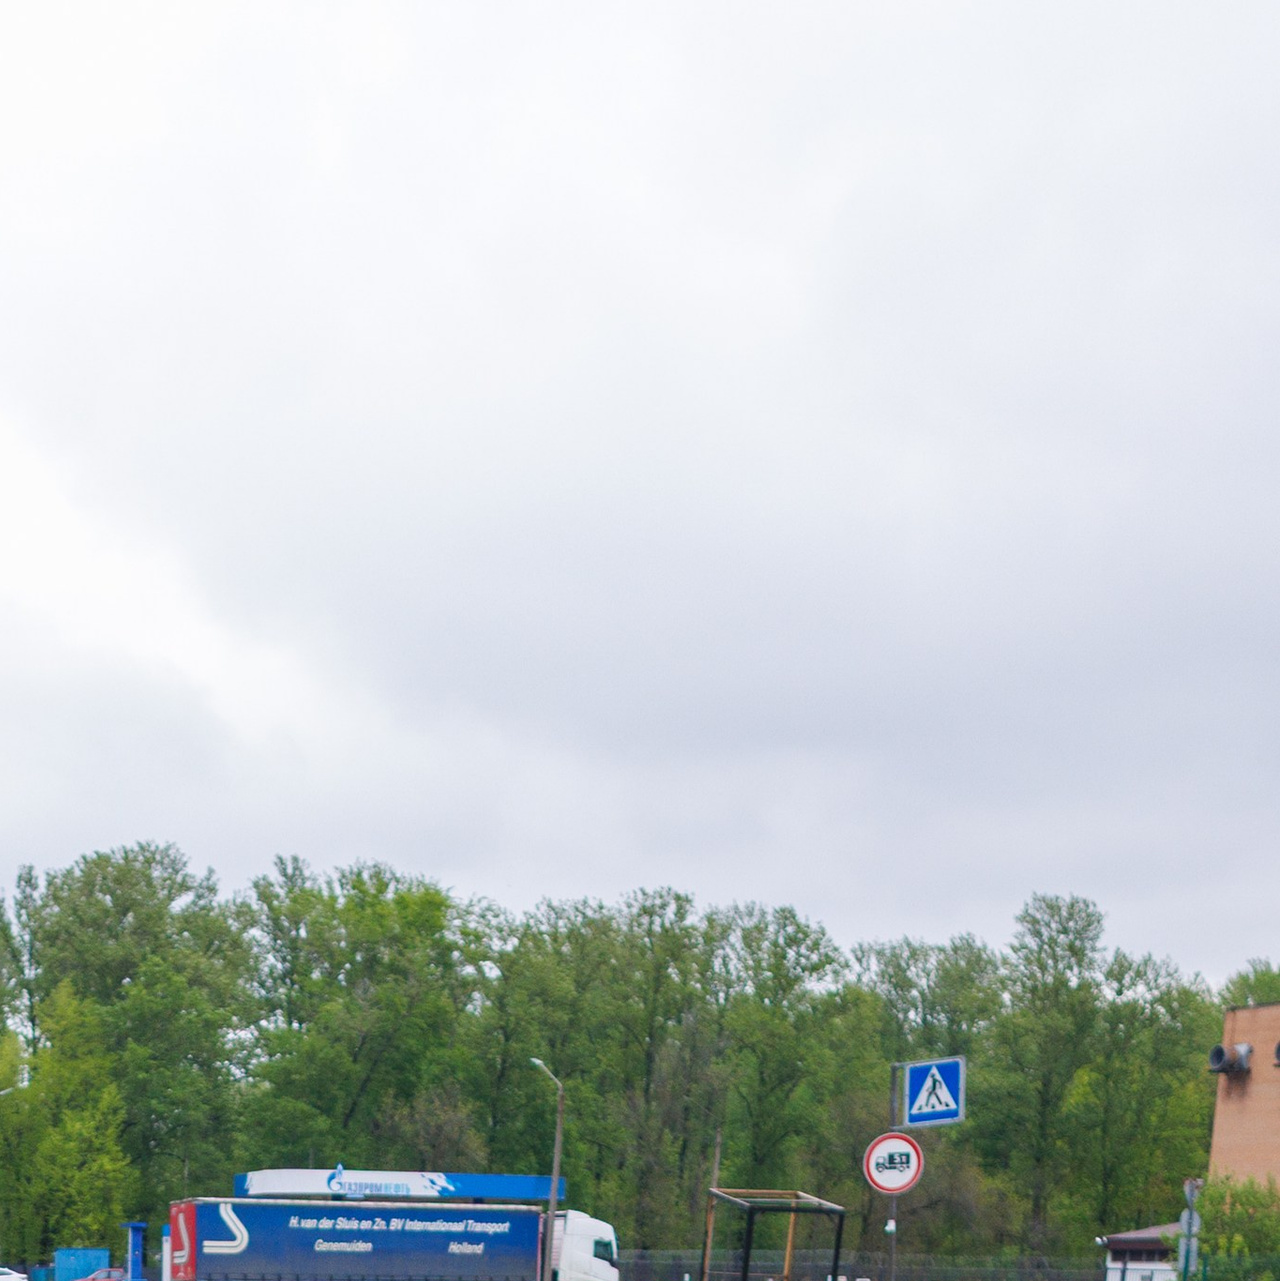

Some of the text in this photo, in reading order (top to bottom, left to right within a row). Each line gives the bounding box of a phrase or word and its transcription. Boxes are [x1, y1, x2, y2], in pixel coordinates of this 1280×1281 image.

[300, 1218, 317, 1228] van
[318, 1217, 334, 1229] der
[335, 1217, 359, 1230] Sluis
[360, 1220, 372, 1230] en
[389, 1218, 405, 1231] BV
[467, 1220, 511, 1235] Transport
[314, 1239, 373, 1252] Genemuiden
[448, 1242, 484, 1253] Holland
